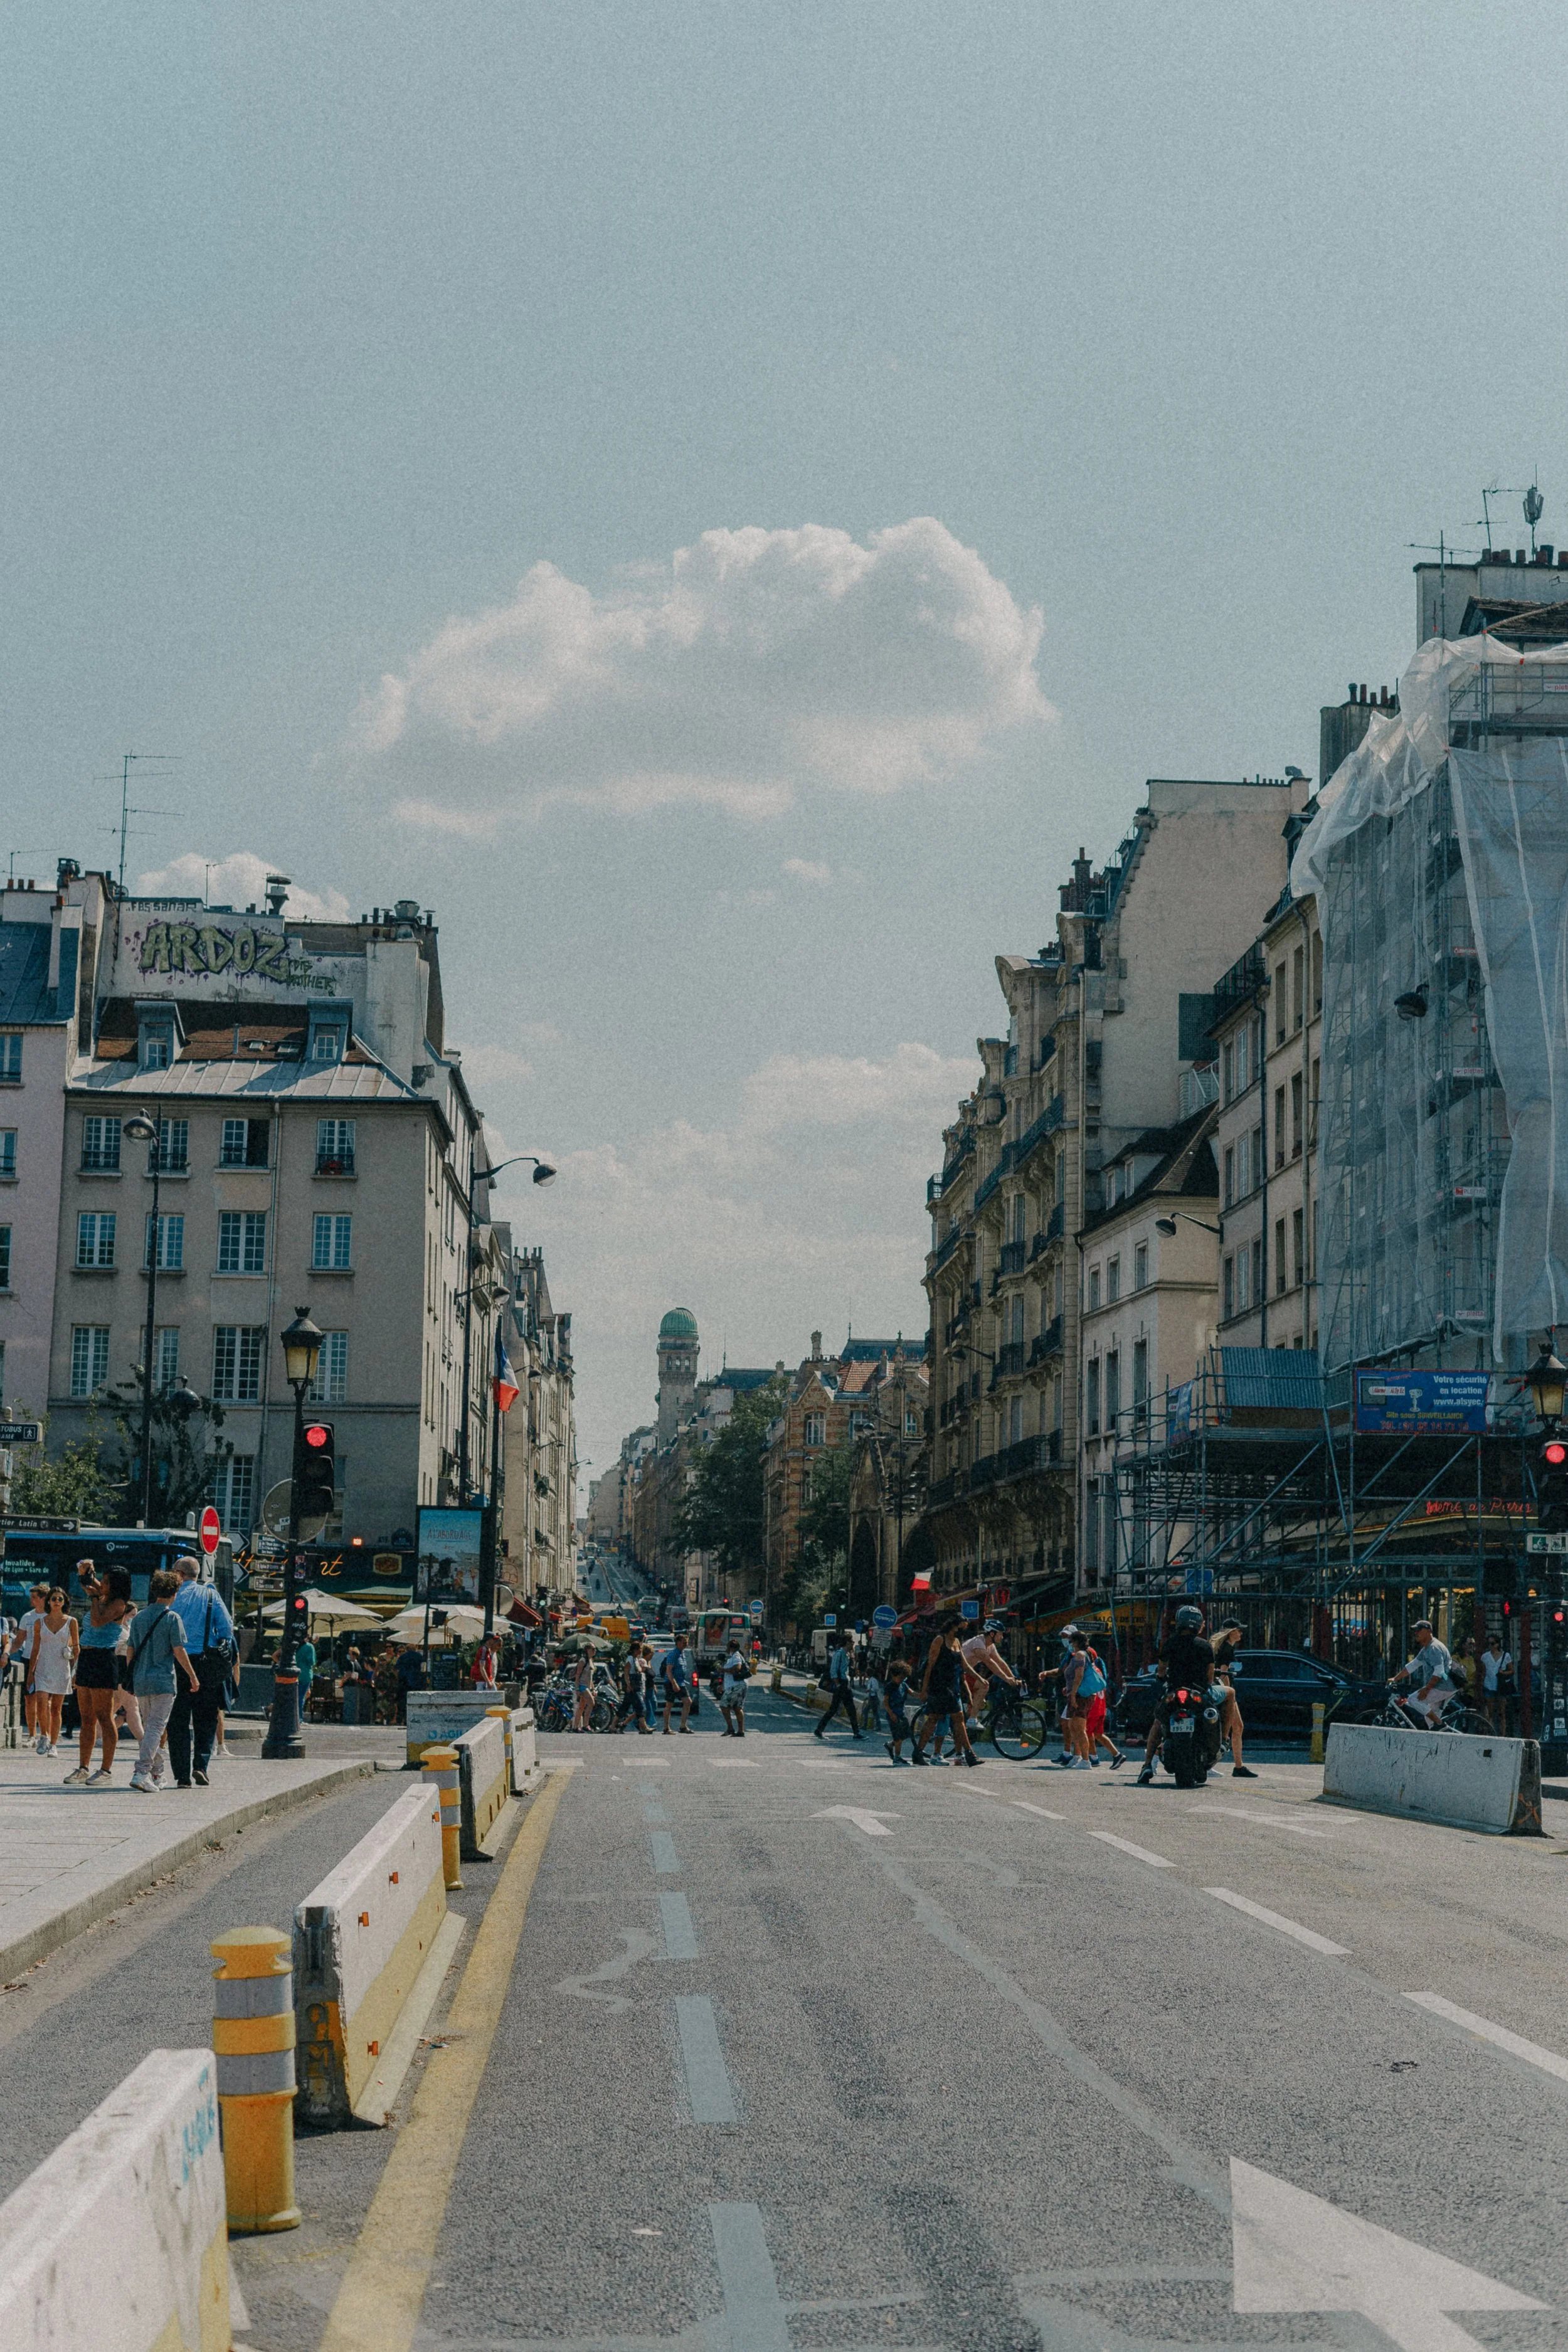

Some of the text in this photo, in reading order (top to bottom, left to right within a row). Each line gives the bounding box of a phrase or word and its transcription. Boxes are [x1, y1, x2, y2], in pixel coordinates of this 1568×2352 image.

[139, 920, 289, 983] ARDOZ
[1433, 1375, 1487, 1384] Votre sécurité
